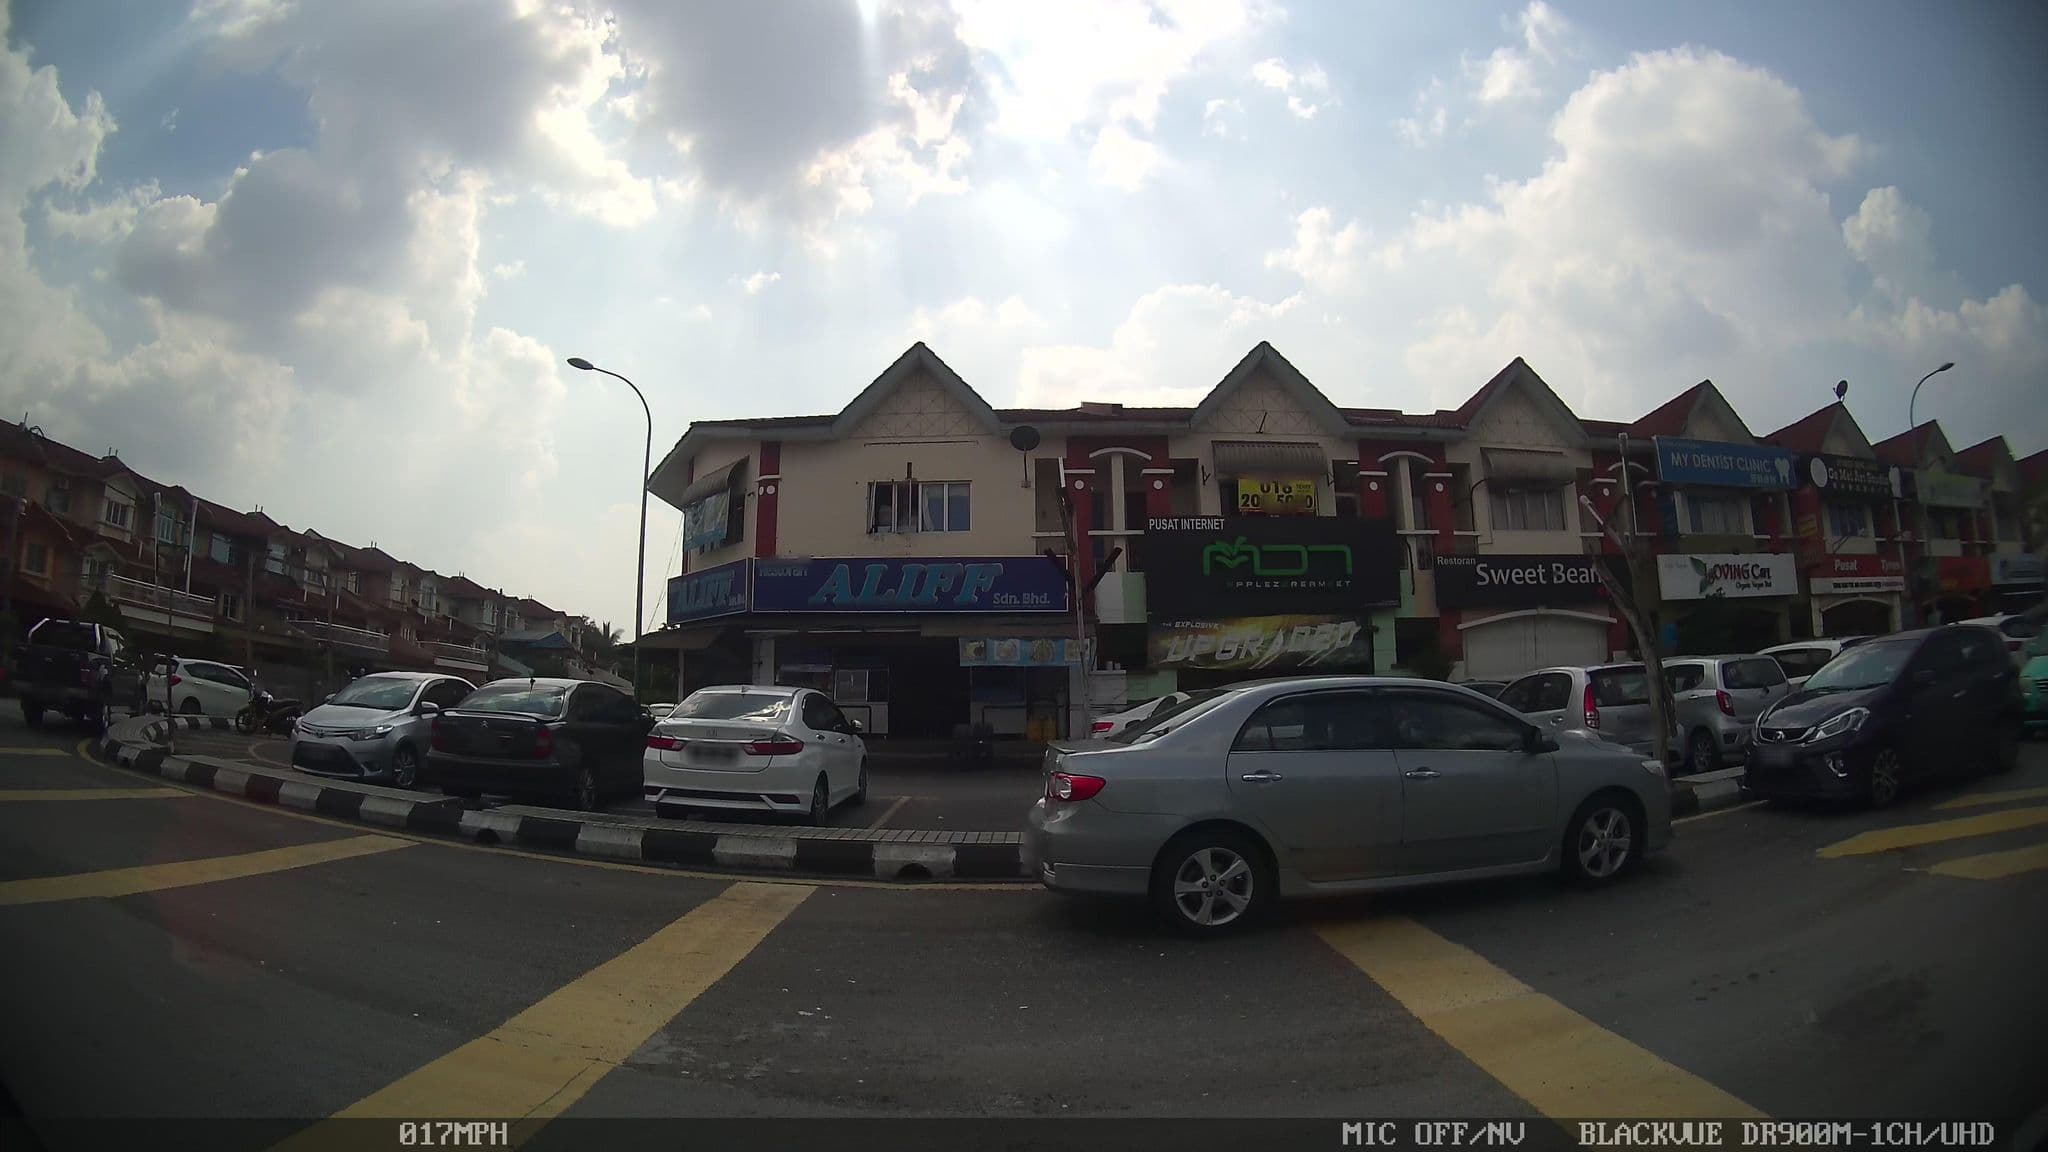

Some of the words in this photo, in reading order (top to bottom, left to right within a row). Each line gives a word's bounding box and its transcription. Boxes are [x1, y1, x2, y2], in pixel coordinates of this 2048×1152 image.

[1671, 451, 1688, 467] MY
[1736, 457, 1772, 473] CLINIC
[1148, 518, 1180, 531] PUSAT
[1181, 518, 1225, 531] INTERNET
[1437, 556, 1477, 566] Restoran
[1476, 562, 1548, 586] Sweet
[808, 562, 1004, 606] ALIFF
[992, 592, 1020, 605] Sdn.
[1022, 591, 1050, 605] Bhd.
